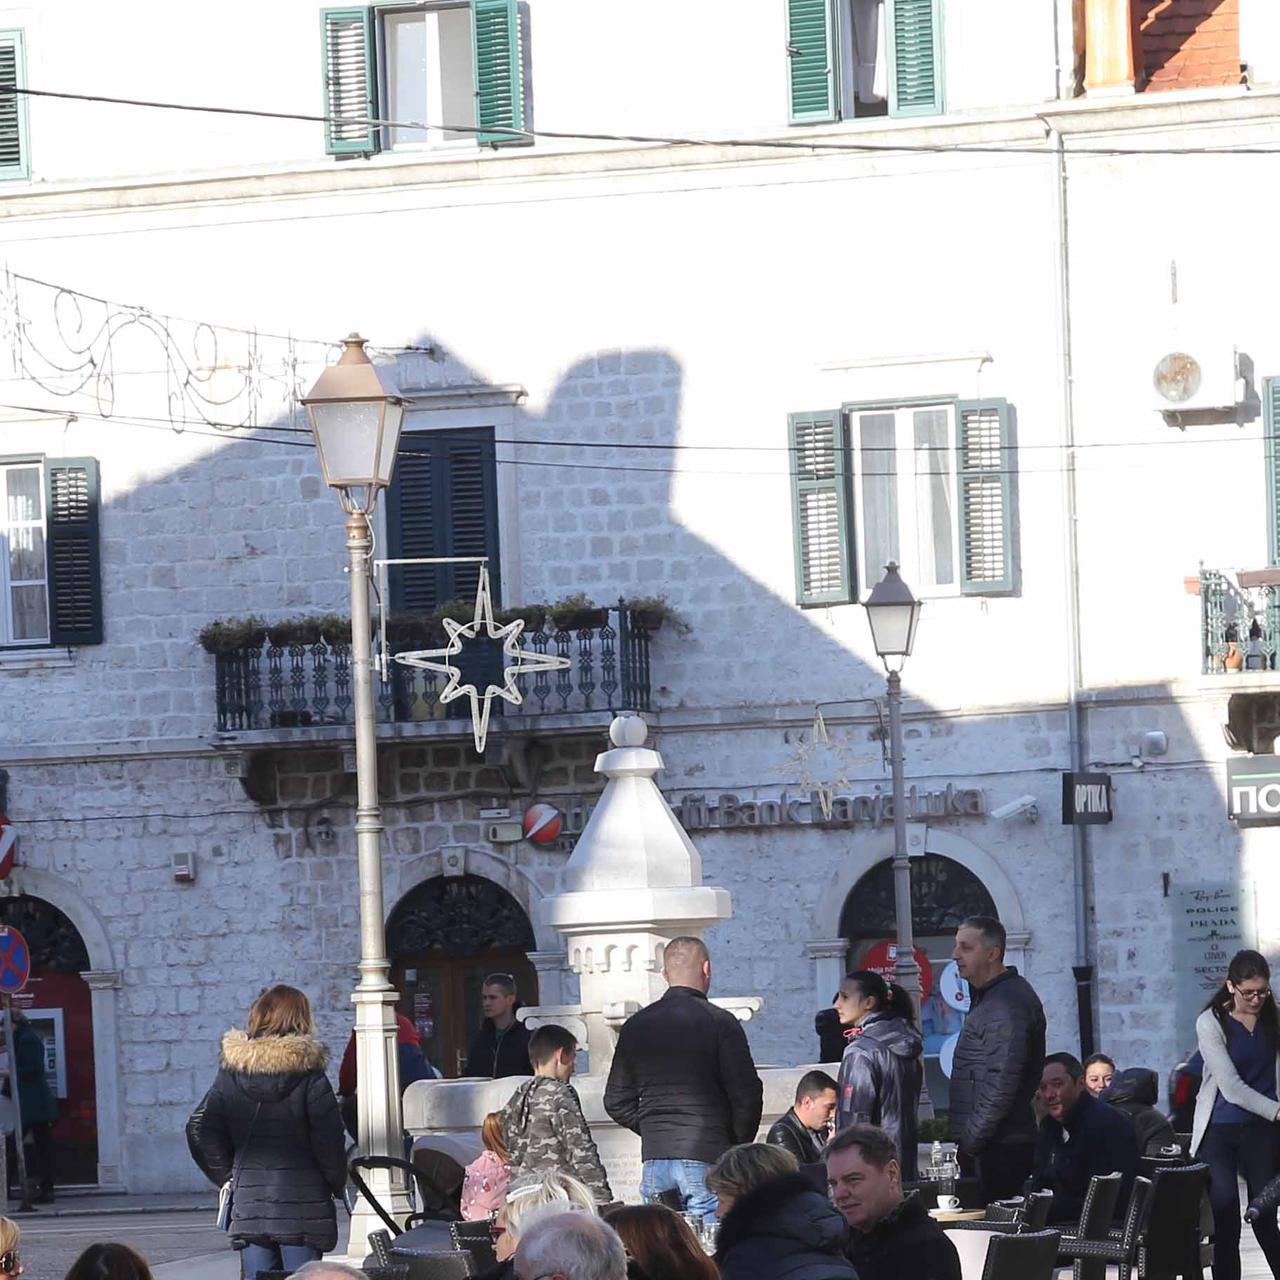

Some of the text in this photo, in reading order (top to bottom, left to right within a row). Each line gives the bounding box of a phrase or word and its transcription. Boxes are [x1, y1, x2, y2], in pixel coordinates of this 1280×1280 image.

[1074, 783, 1108, 813] OPTIKA
[719, 790, 801, 826] Bank
[1186, 906, 1239, 914] POLICE
[1190, 919, 1237, 928] PRADA
[1194, 966, 1229, 974] SECTO
